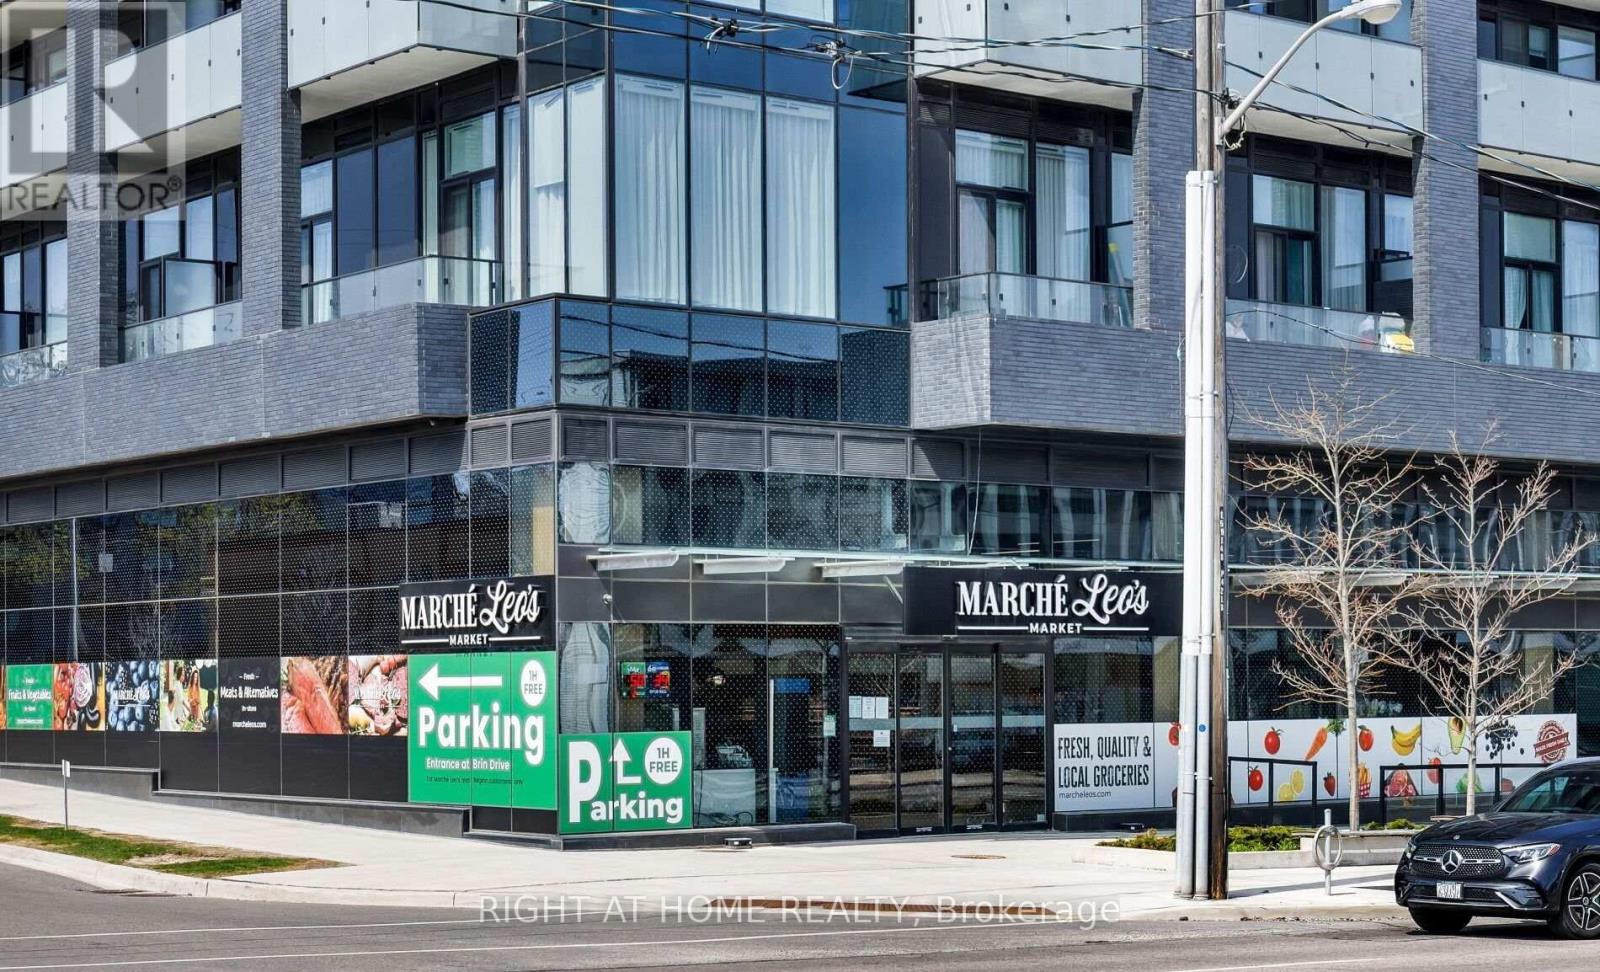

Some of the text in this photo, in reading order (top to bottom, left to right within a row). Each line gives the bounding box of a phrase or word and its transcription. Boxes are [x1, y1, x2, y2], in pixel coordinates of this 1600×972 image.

[957, 573, 1150, 625] MARCHÉ Leo's
[400, 580, 541, 635] MARCHÉ Leo's
[1029, 622, 1083, 634] MARKET
[449, 633, 489, 646] MARKET
[529, 669, 538, 681] 1H
[8, 688, 22, 700] Fruits
[27, 688, 52, 702] Vegetables
[220, 686, 238, 699] Meats
[244, 686, 278, 698] Alternatives
[523, 683, 543, 695] FREE
[418, 701, 545, 766] Parking
[656, 747, 670, 759] 1H
[1058, 736, 1152, 760] FRESH, QUALITY &
[426, 758, 510, 771] Entrance at Brin Drive
[649, 761, 679, 773] FREE
[1058, 764, 1150, 788] LOCAL GROCERIES
[1058, 790, 1112, 800] marcheleos.com
